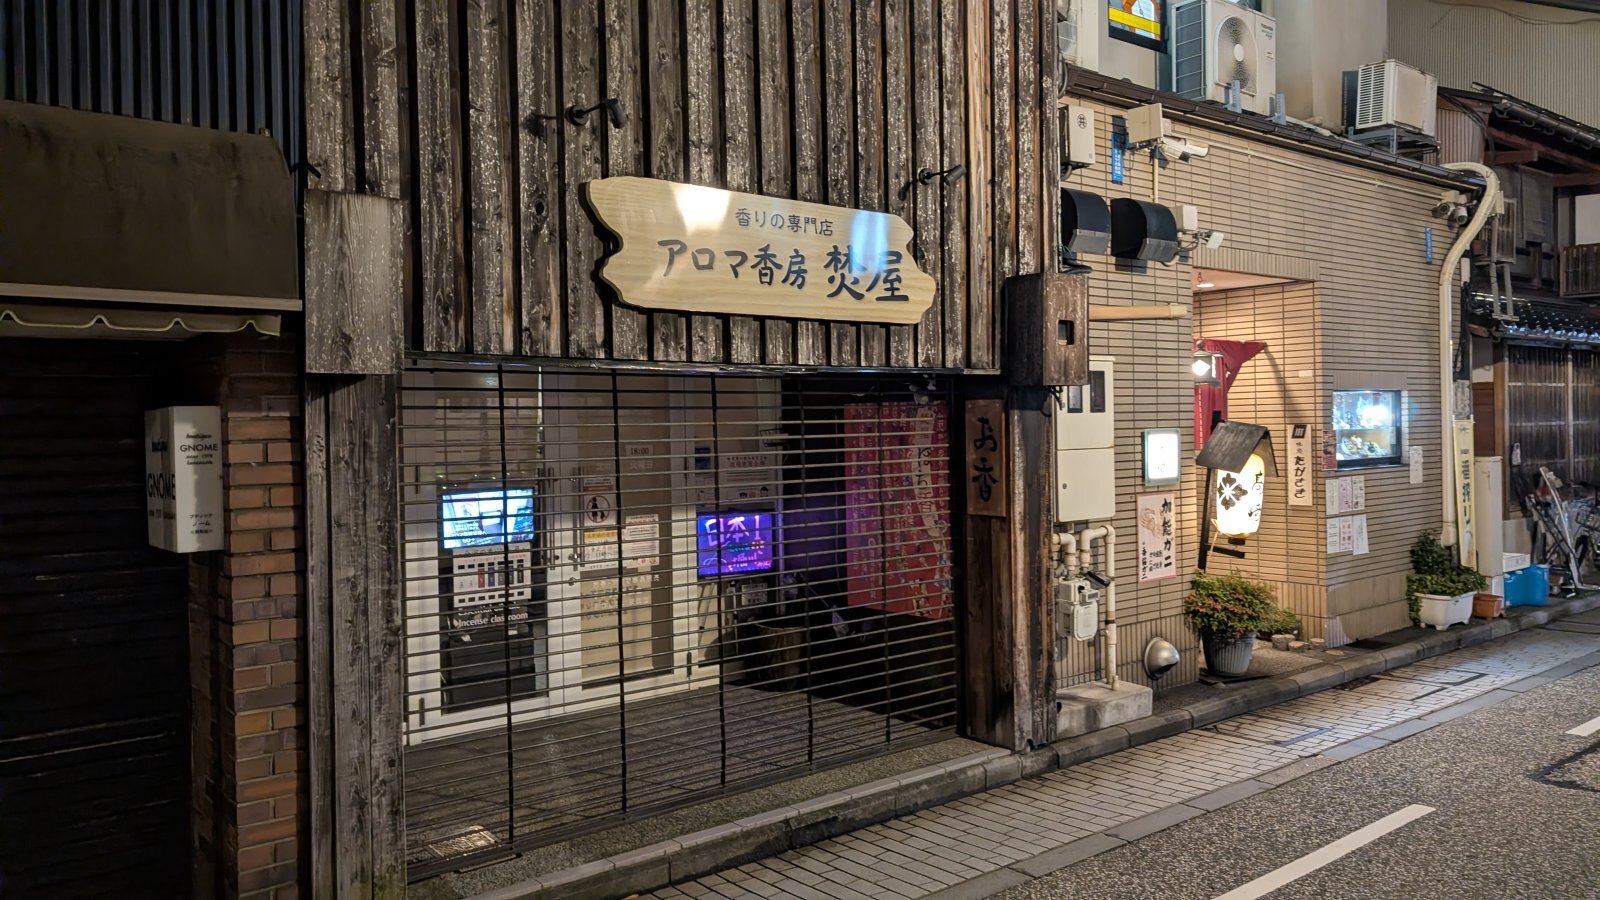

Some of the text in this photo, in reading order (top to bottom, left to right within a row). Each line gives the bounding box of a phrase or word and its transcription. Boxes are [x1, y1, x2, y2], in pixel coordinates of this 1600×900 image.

[735, 208, 834, 237] 香りの専門店
[657, 239, 910, 302] アロマ香房 焚屋
[179, 443, 218, 453] GNOME
[972, 416, 999, 502] お香
[147, 473, 176, 500] GNOME
[458, 612, 529, 628] Incense clasroom
